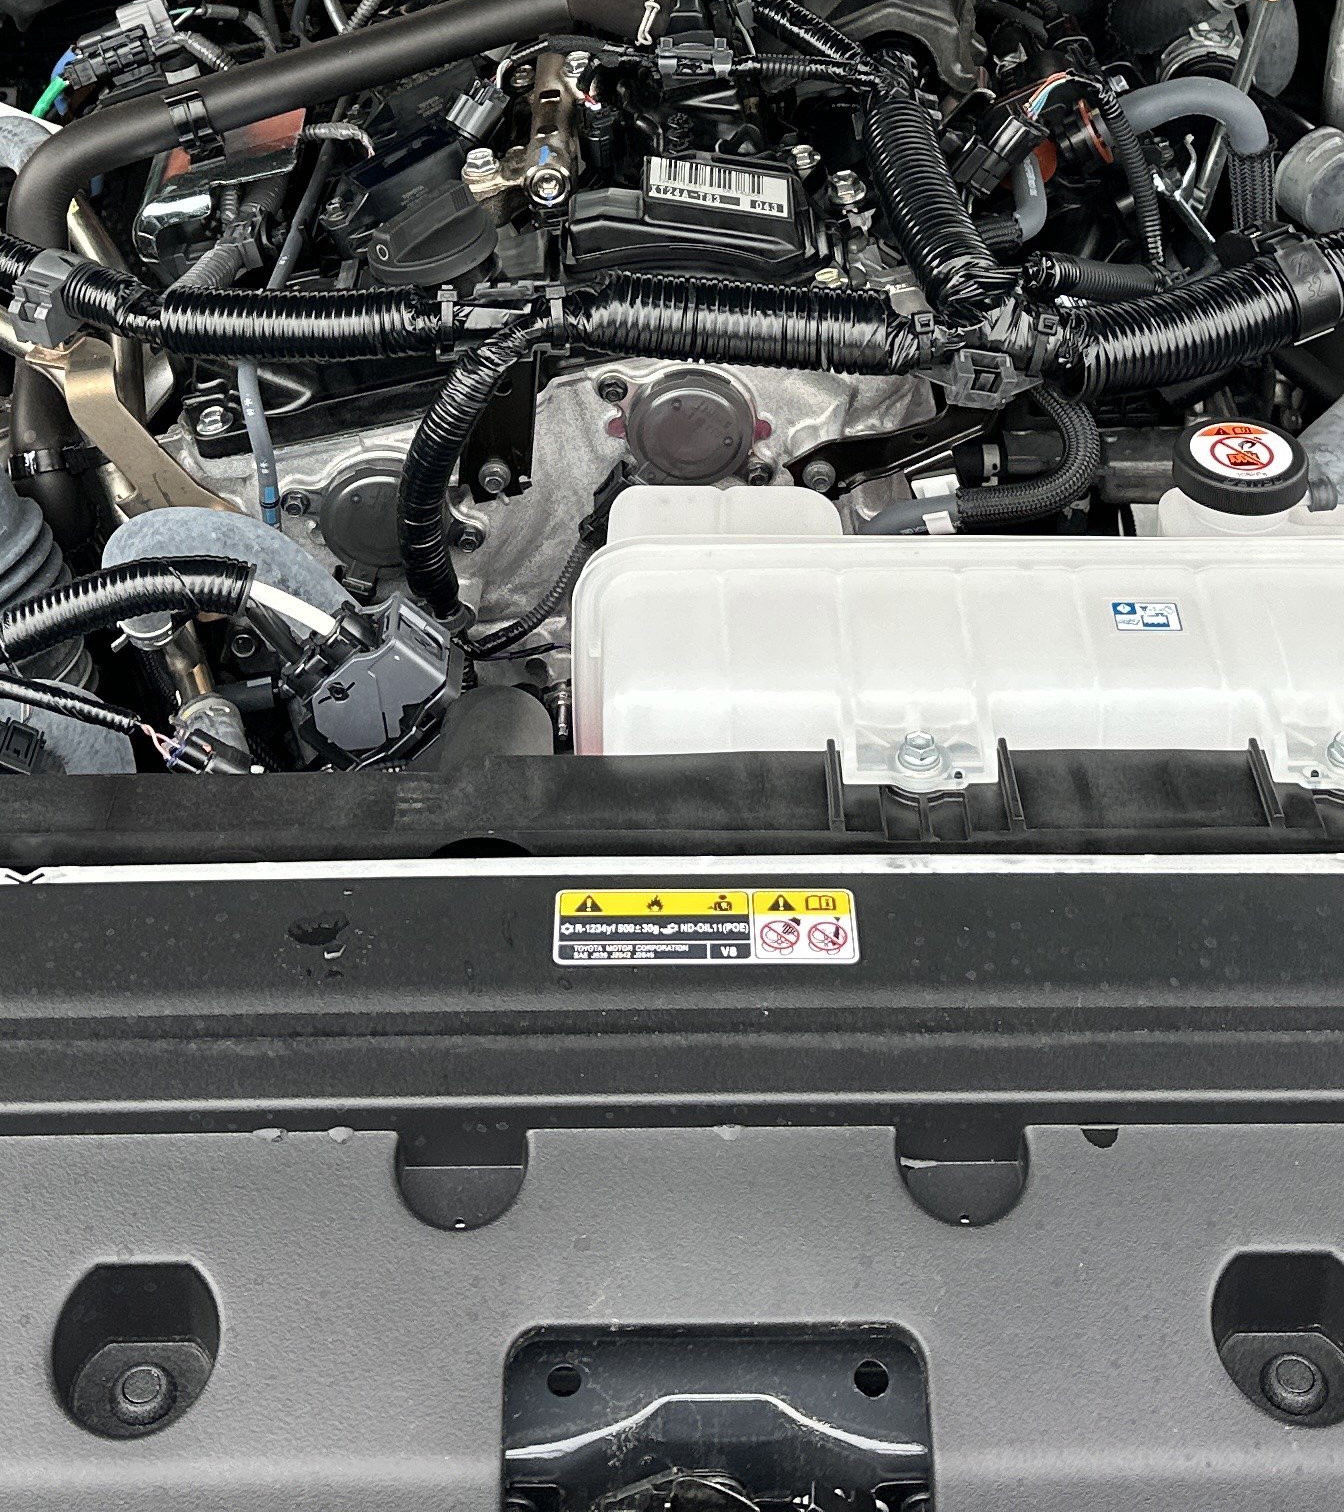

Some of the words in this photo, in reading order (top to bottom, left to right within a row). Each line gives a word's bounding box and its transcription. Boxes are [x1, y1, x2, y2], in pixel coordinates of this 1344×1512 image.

[649, 184, 721, 203] XT24A-T83
[755, 201, 778, 212] 043
[574, 923, 617, 935] R-1234yf
[680, 922, 749, 935] ND-OIL11(POE)
[573, 944, 603, 952] TOYOTA
[605, 944, 633, 952] MOTOR
[635, 944, 689, 952] CORPORATION
